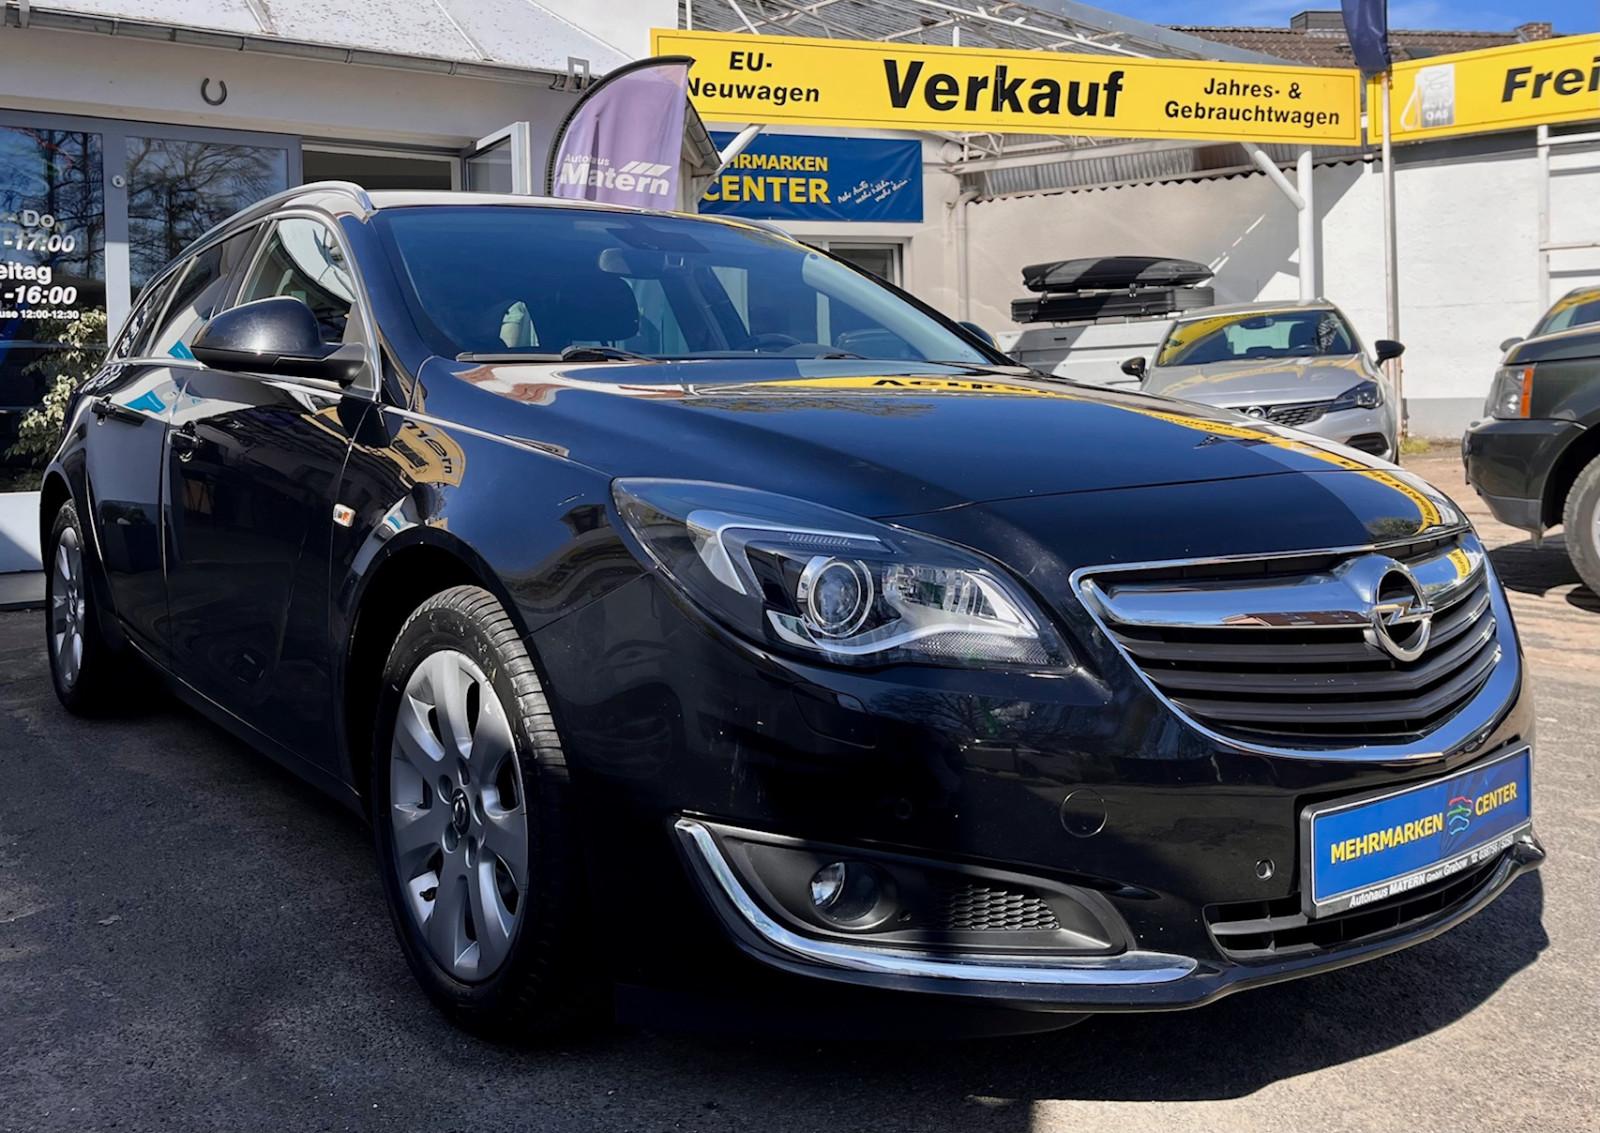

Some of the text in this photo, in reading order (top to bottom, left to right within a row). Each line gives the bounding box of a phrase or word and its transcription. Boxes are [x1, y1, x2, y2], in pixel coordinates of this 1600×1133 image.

[729, 51, 773, 72] EU-
[688, 77, 820, 106] Neuwagen
[883, 59, 1125, 118] Verkauf
[1203, 77, 1303, 100] Jahres- &
[1501, 56, 1600, 103] Frei
[1164, 100, 1341, 129] Gebrauchtwagen
[560, 163, 670, 196] Matern
[23, 209, 55, 228] Do
[4, 285, 78, 305] -16:00
[20, 309, 79, 320] 12:00-12:30
[1330, 812, 1443, 865] MEHRMARKEN
[1475, 781, 1517, 816] CENTER
[1349, 887, 1389, 908] Autohaus
[1389, 873, 1426, 895] MATERN
